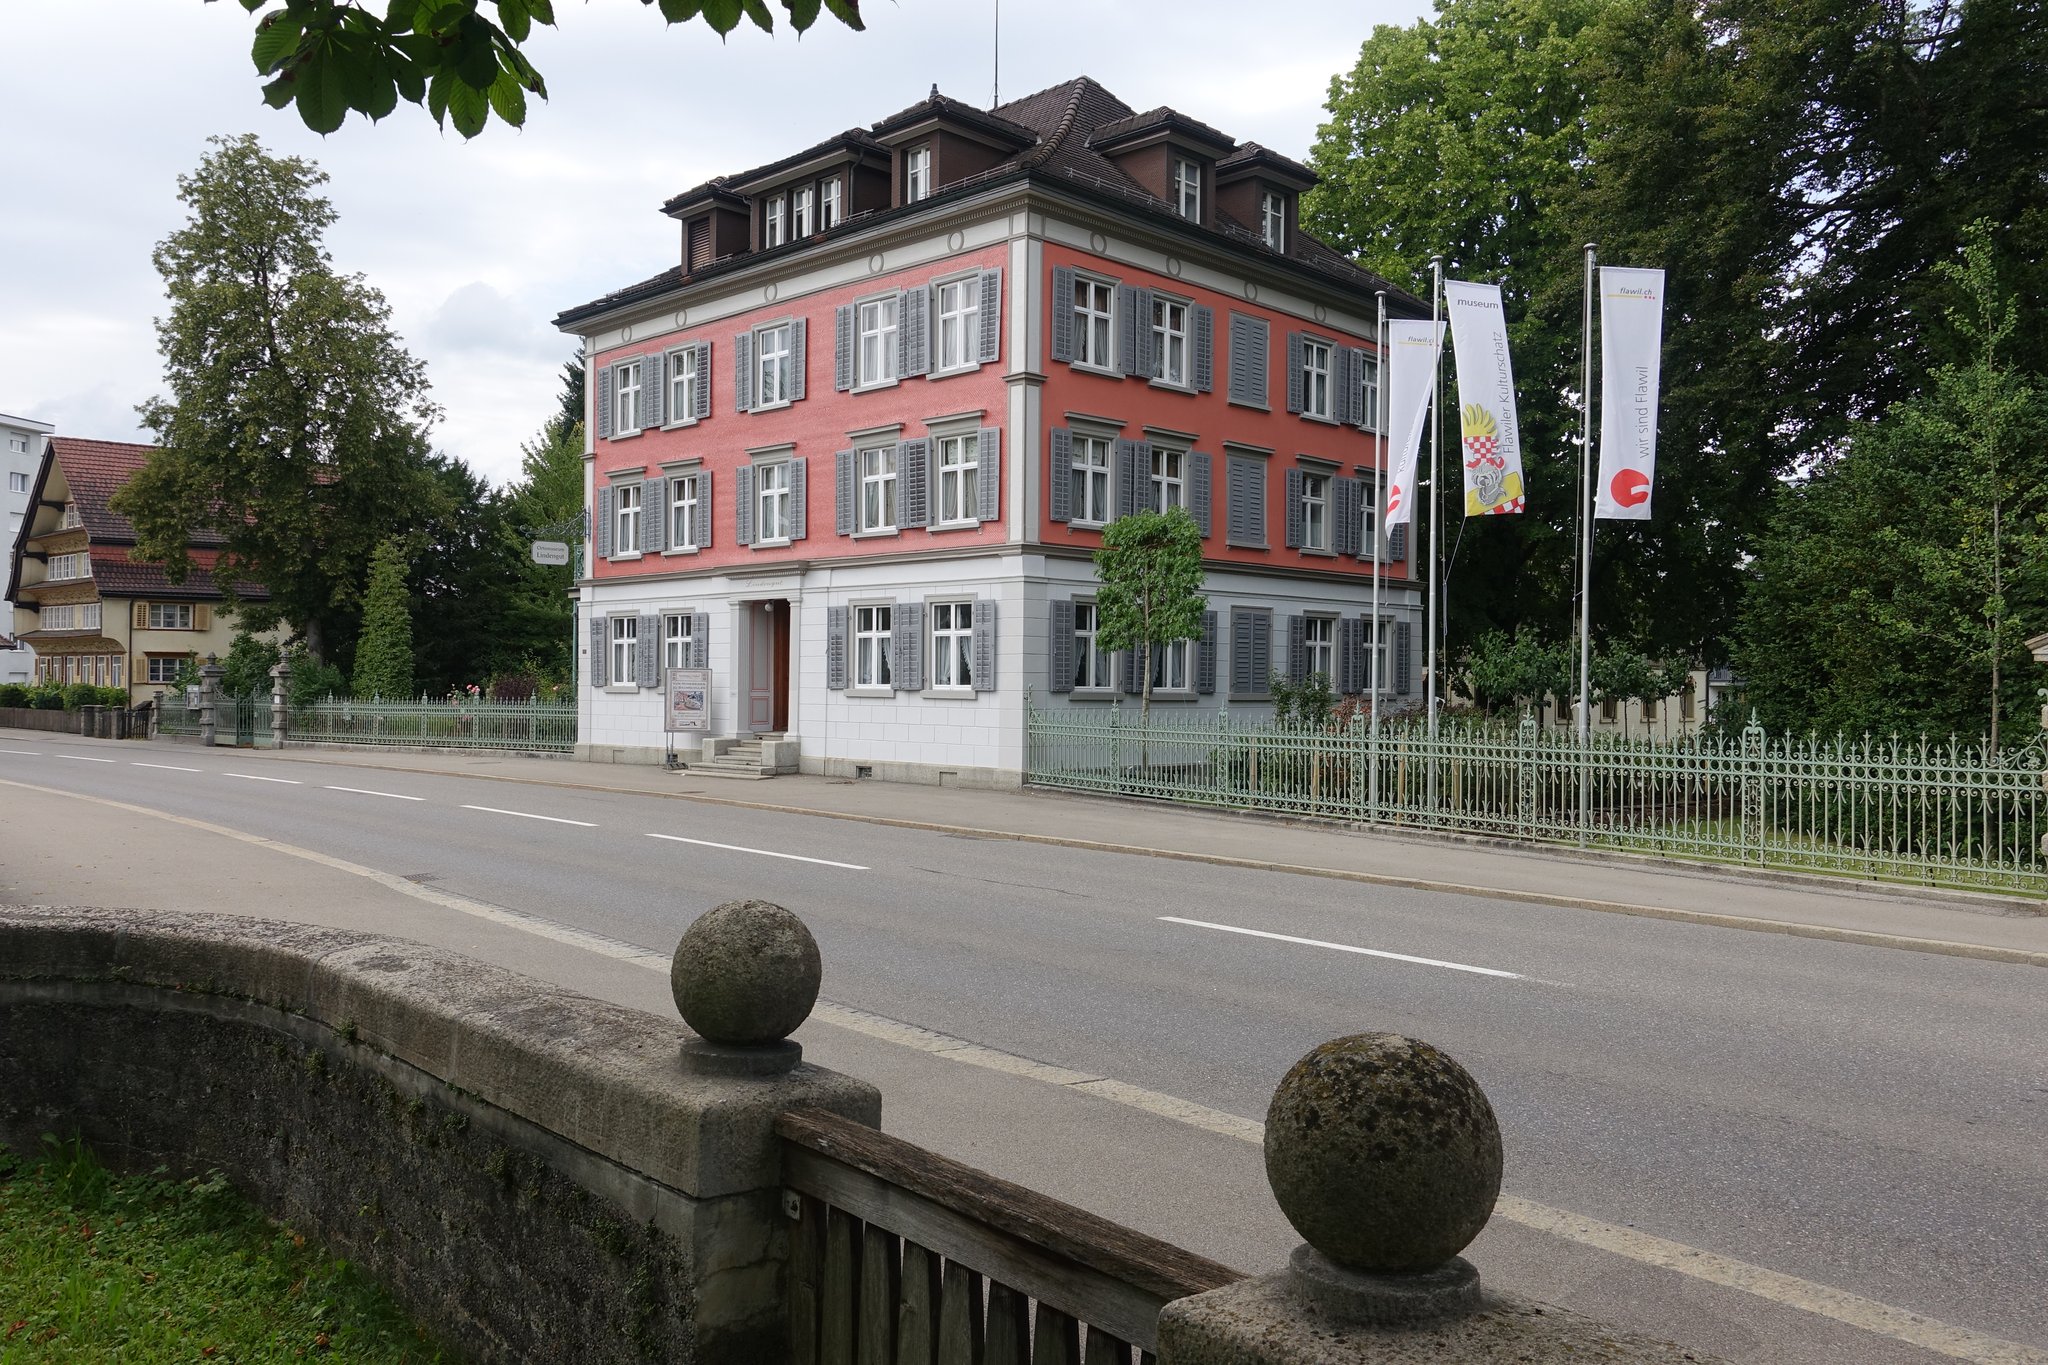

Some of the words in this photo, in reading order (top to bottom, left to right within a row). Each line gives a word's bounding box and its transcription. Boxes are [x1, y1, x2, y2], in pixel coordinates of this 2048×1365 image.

[1457, 298, 1499, 309] museum
[1619, 287, 1652, 296] flawil.ch
[1493, 331, 1510, 403] Kulturschatz
[1635, 366, 1649, 403] Flawil
[1500, 407, 1515, 454] Flawiler
[1636, 407, 1649, 432] sind
[1636, 437, 1650, 459] wir
